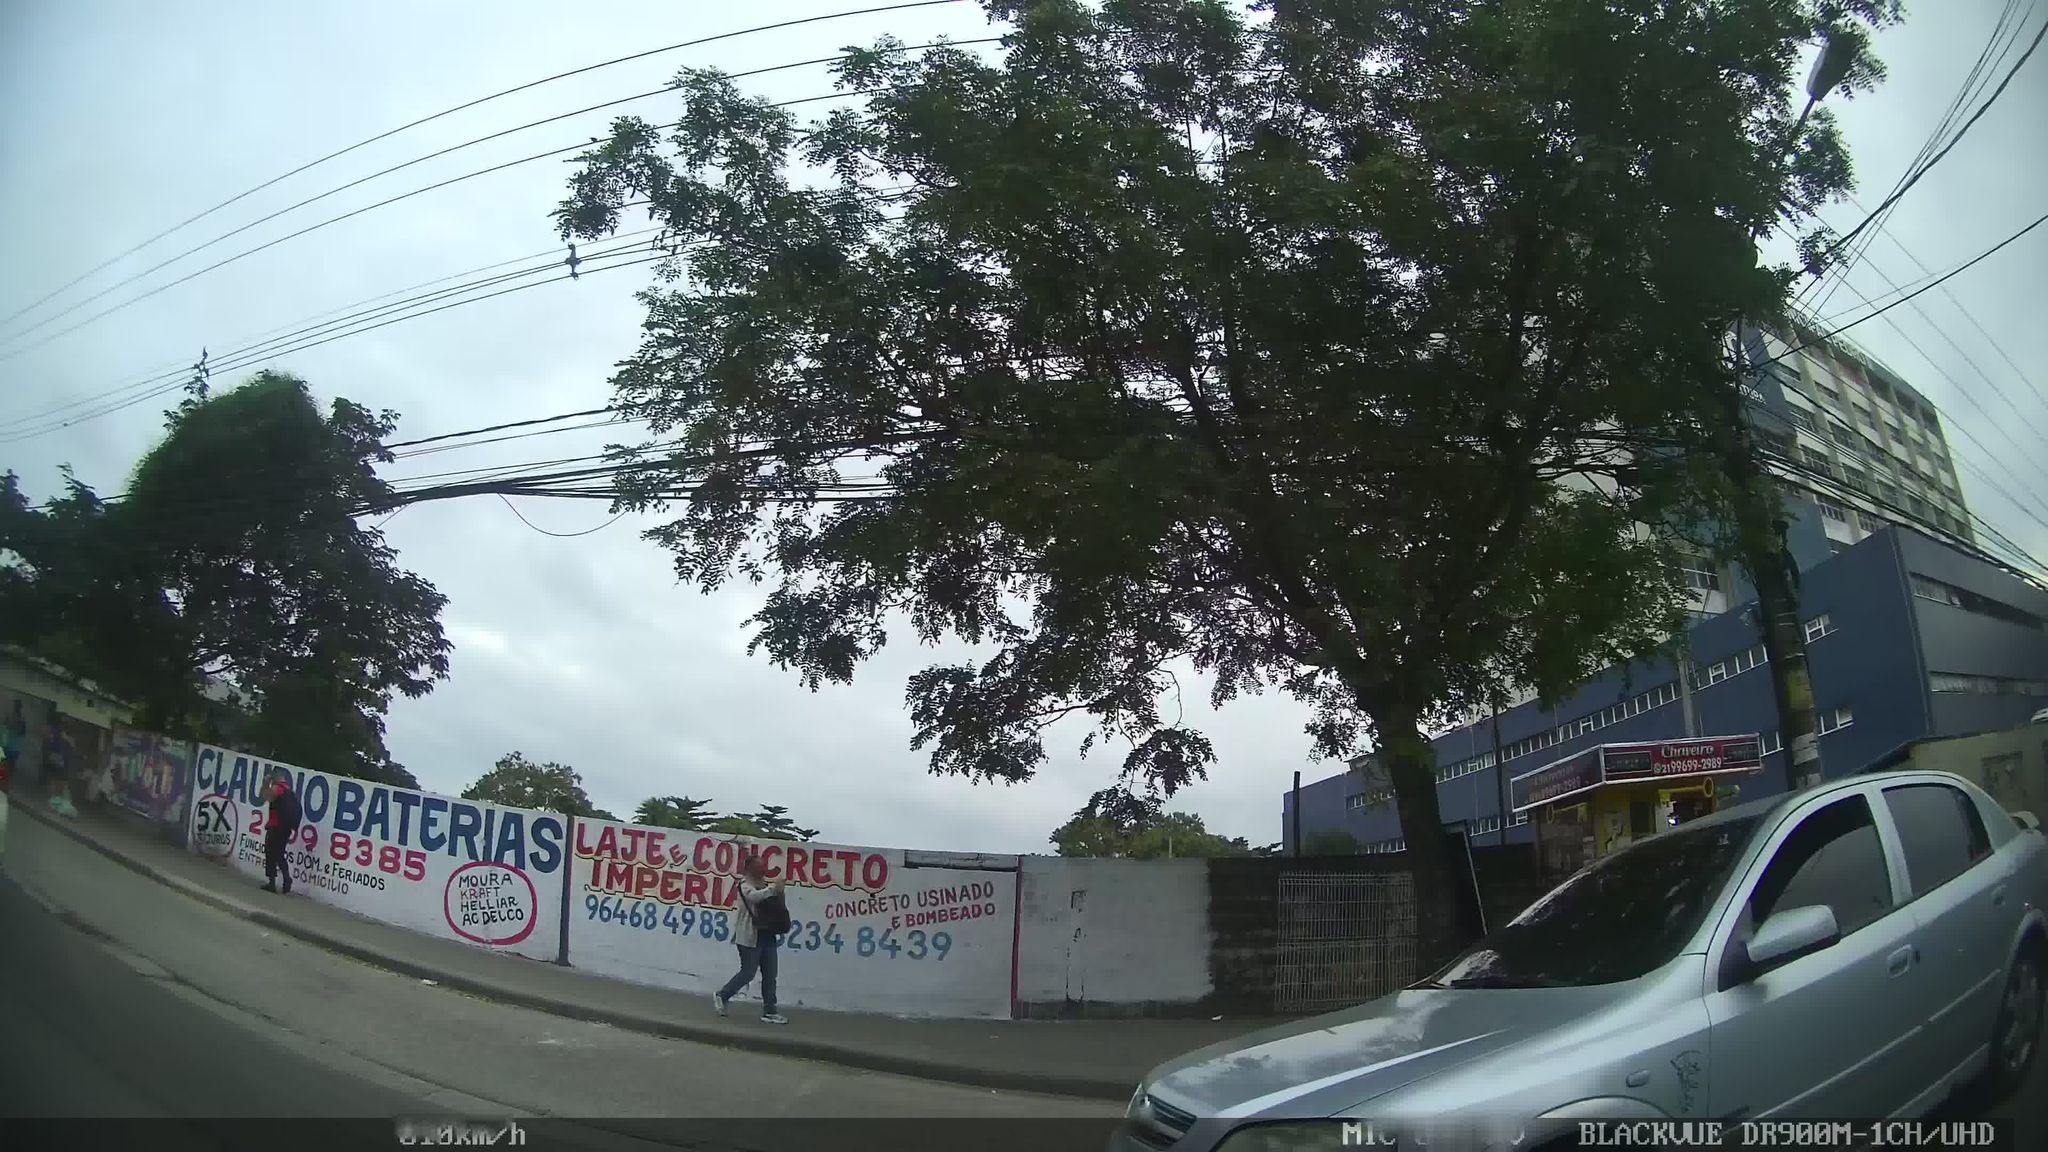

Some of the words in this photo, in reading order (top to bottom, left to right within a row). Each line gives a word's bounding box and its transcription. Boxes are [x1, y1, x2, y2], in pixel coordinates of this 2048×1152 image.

[198, 800, 232, 832] 5X
[334, 780, 563, 873] BATERIAS
[330, 832, 427, 881] 8385
[576, 822, 667, 866] LAJE
[693, 837, 889, 889] CONCRETO
[293, 868, 349, 894] DOMICILIO
[332, 862, 385, 890] FERIADOS
[458, 872, 514, 889] MOURA
[460, 886, 501, 900] KRAFT
[460, 896, 519, 912] HELLIAR
[825, 892, 910, 919] CONCRETO
[917, 881, 994, 907] USINADO
[462, 912, 479, 926] AC
[483, 908, 524, 925] DELCO
[585, 894, 657, 930] 96468
[663, 905, 729, 942] 4983
[856, 926, 953, 961] 8439
[891, 916, 901, 930] E
[906, 902, 996, 927] BOMBEADO
